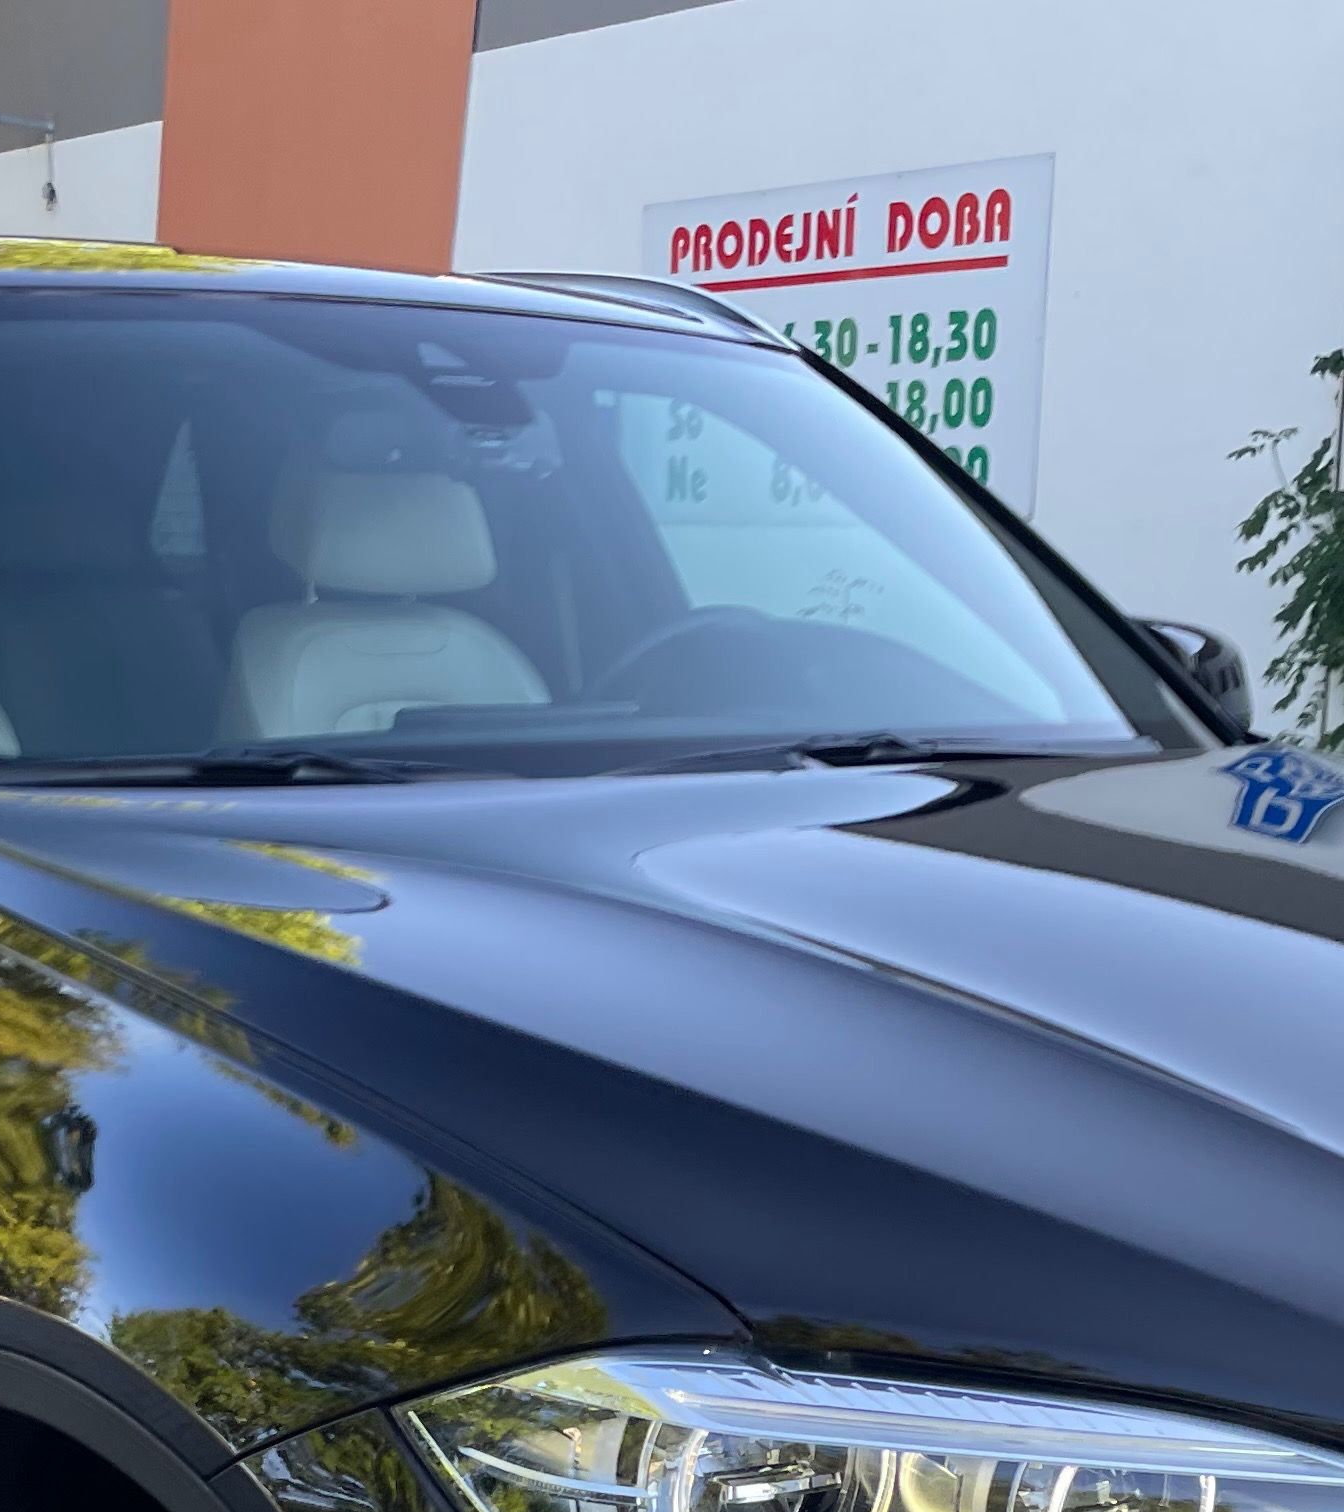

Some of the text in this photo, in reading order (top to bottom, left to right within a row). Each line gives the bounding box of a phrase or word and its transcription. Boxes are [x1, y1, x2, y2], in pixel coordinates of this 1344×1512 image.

[670, 188, 1011, 274] PRODEJNÍ DOBA
[666, 455, 709, 503] Ne
